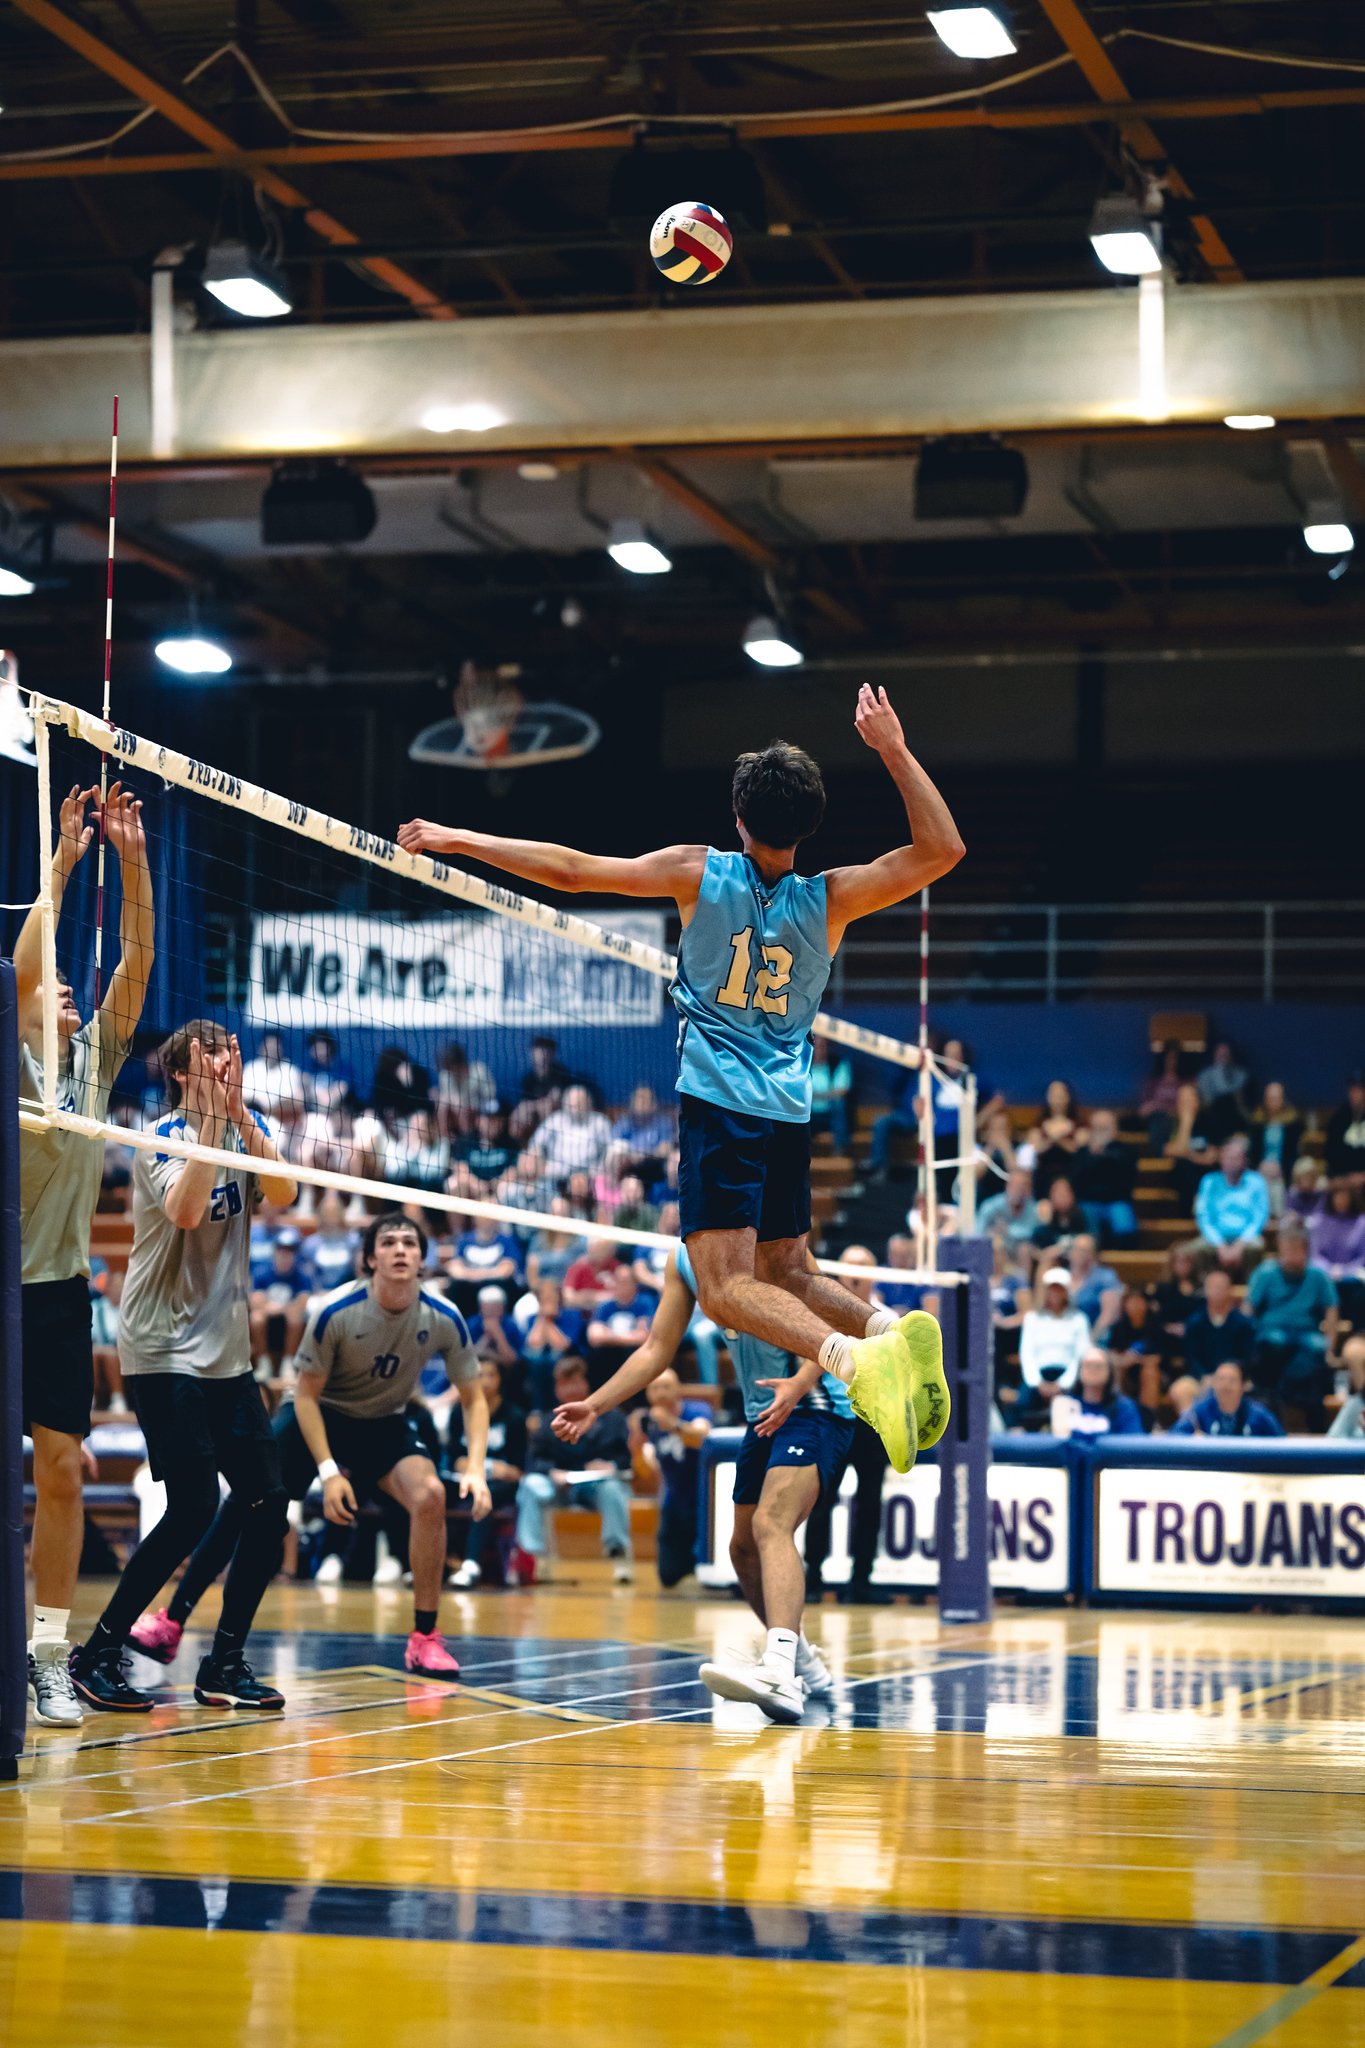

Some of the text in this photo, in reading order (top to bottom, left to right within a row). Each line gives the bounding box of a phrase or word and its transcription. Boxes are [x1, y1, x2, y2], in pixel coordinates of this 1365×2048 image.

[187, 759, 242, 800] TROJANS
[263, 944, 341, 996] We
[715, 925, 793, 1017] 12
[370, 1353, 400, 1379] 10
[1119, 1500, 1365, 1570] TROJANS
